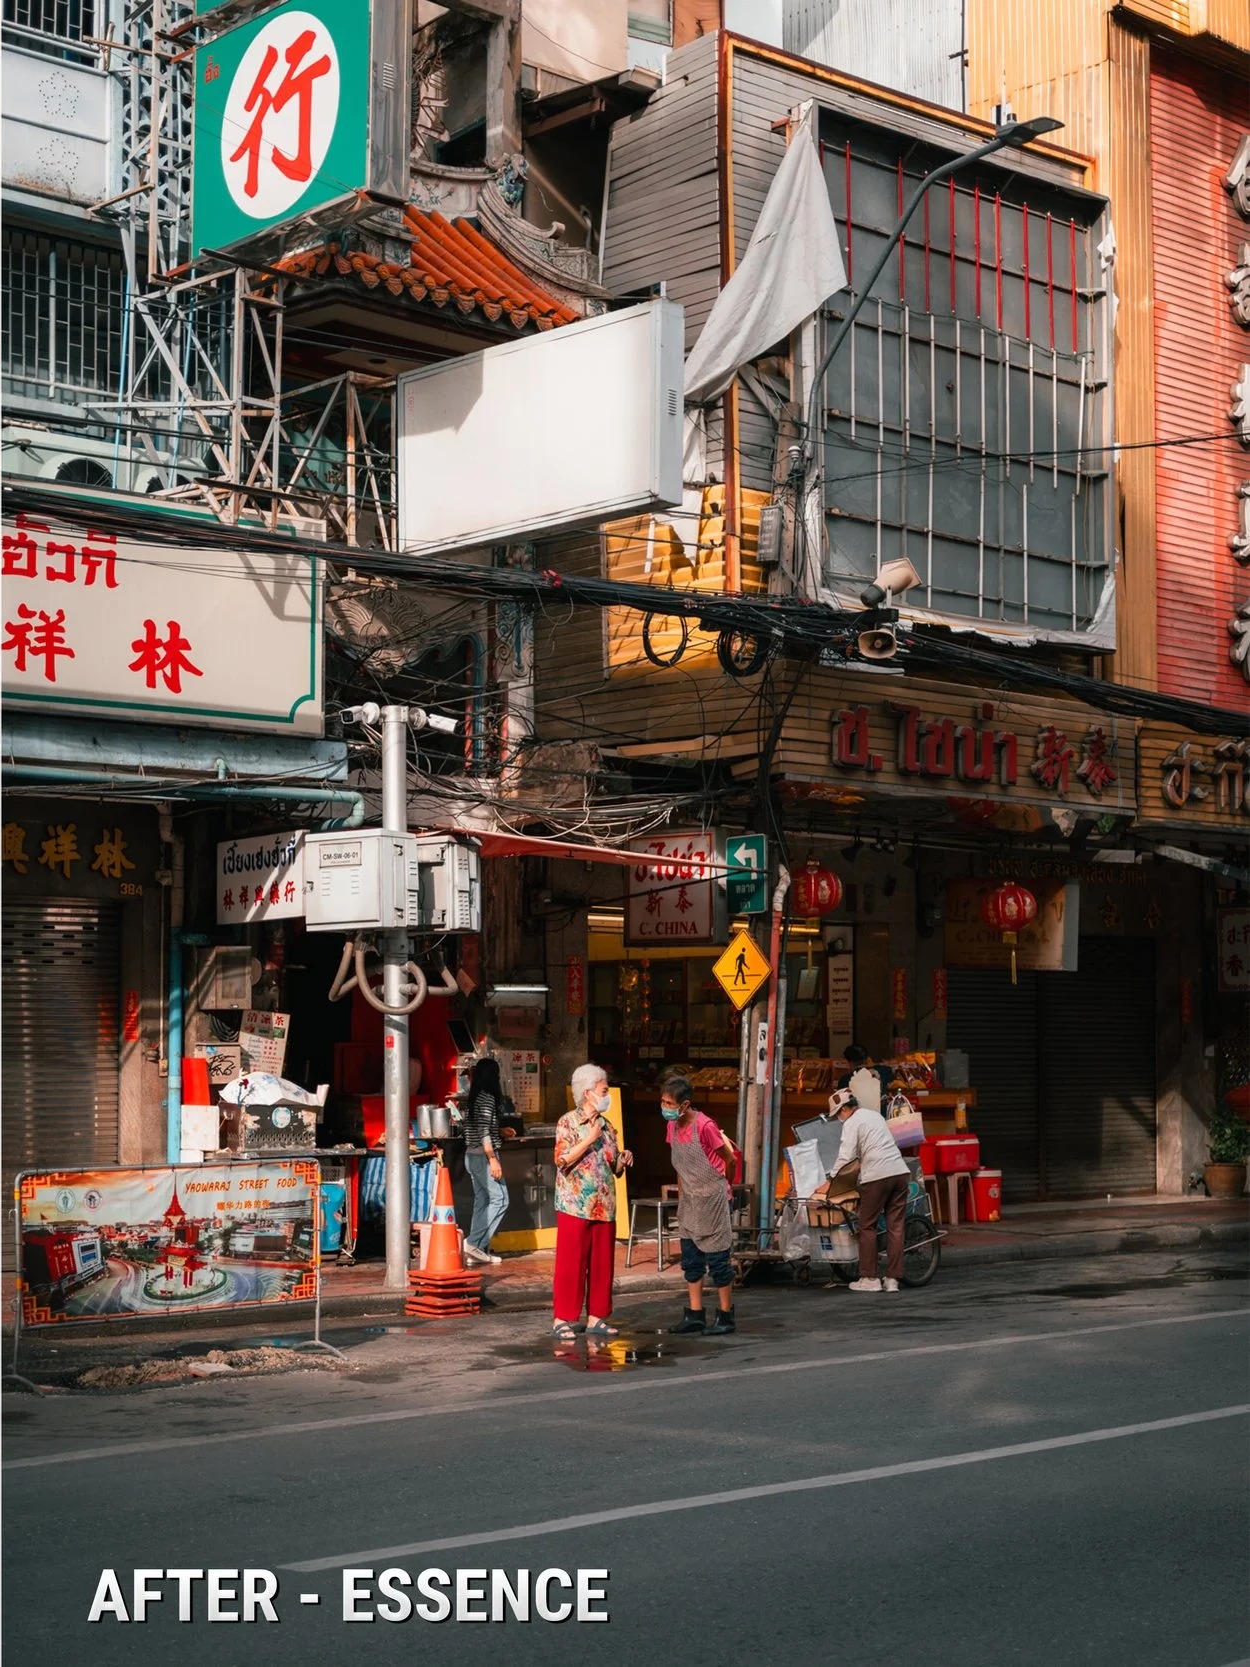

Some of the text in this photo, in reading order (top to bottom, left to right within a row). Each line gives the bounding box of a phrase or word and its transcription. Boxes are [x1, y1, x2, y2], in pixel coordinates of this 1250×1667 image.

[230, 30, 331, 199] 行
[119, 883, 143, 897] 384
[639, 921, 698, 935] C. CHINA
[185, 1177, 297, 1194] YAOWARAJ STREET FOOD
